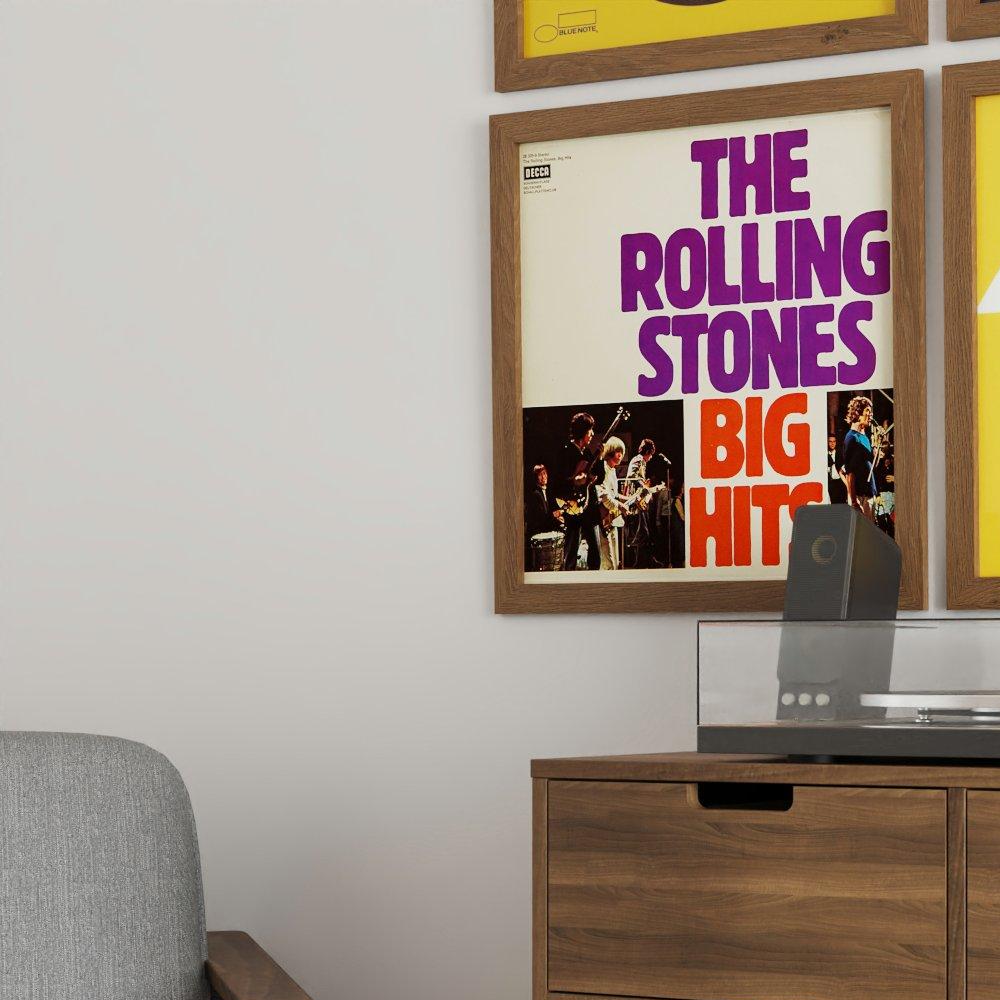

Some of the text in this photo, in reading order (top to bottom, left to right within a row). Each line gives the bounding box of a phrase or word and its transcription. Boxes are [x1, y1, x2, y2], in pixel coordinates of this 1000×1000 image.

[525, 166, 549, 179] DECCA
[690, 128, 810, 219] THE
[620, 210, 891, 312] ROLLING
[638, 300, 877, 397] STONES
[700, 392, 811, 480] BIG
